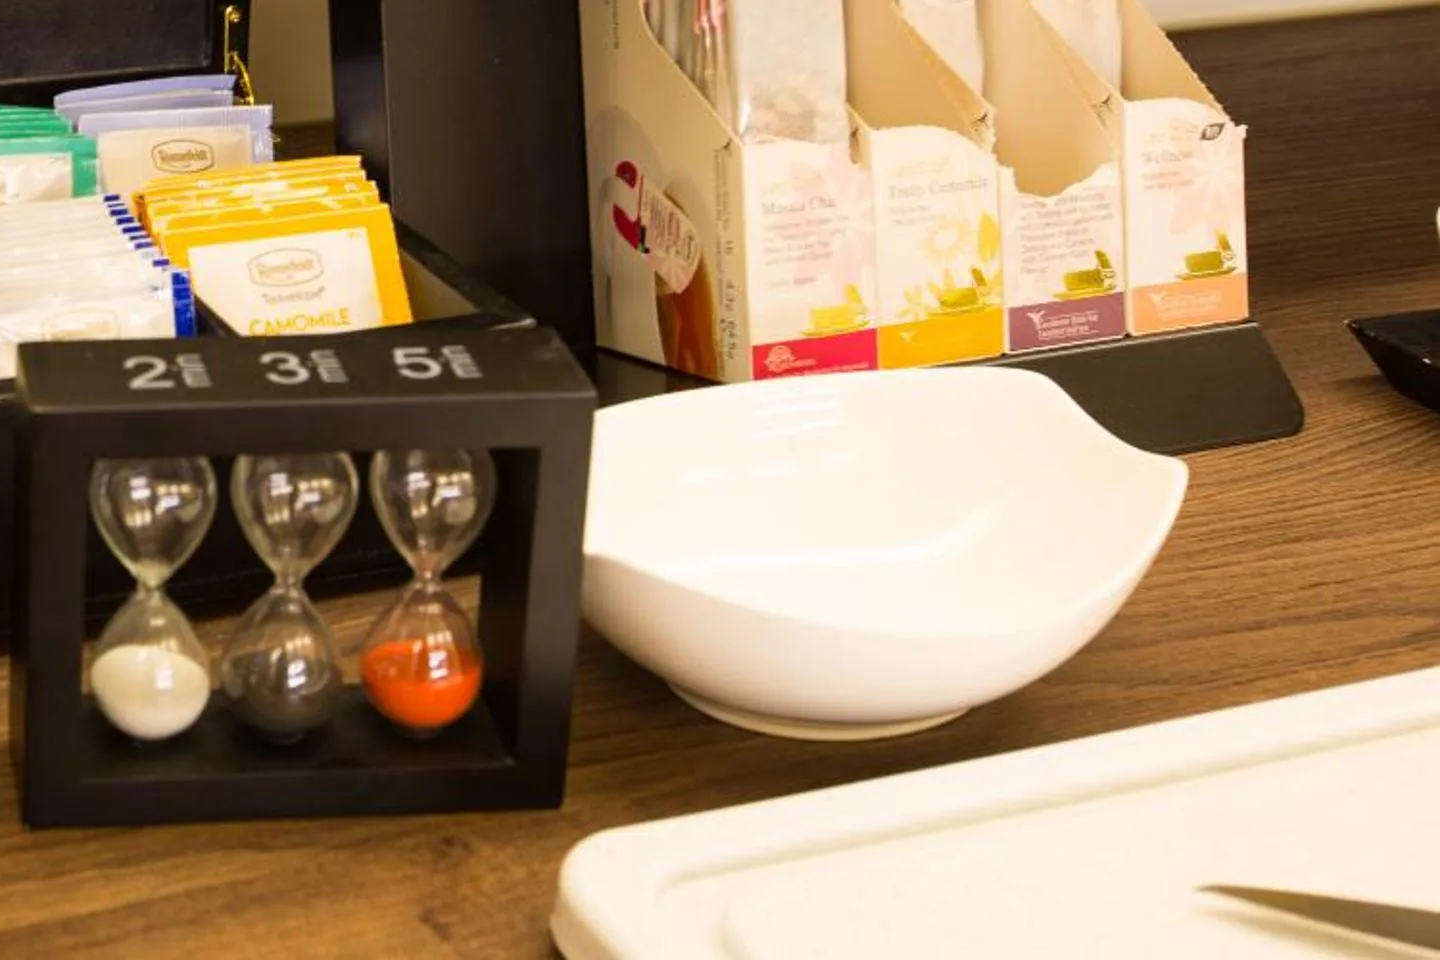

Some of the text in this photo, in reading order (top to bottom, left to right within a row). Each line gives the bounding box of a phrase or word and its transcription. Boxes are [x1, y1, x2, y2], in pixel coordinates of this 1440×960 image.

[249, 307, 353, 336] CAMOMILE
[123, 353, 176, 390] 2
[259, 350, 311, 386] 3
[392, 346, 443, 381] 5
